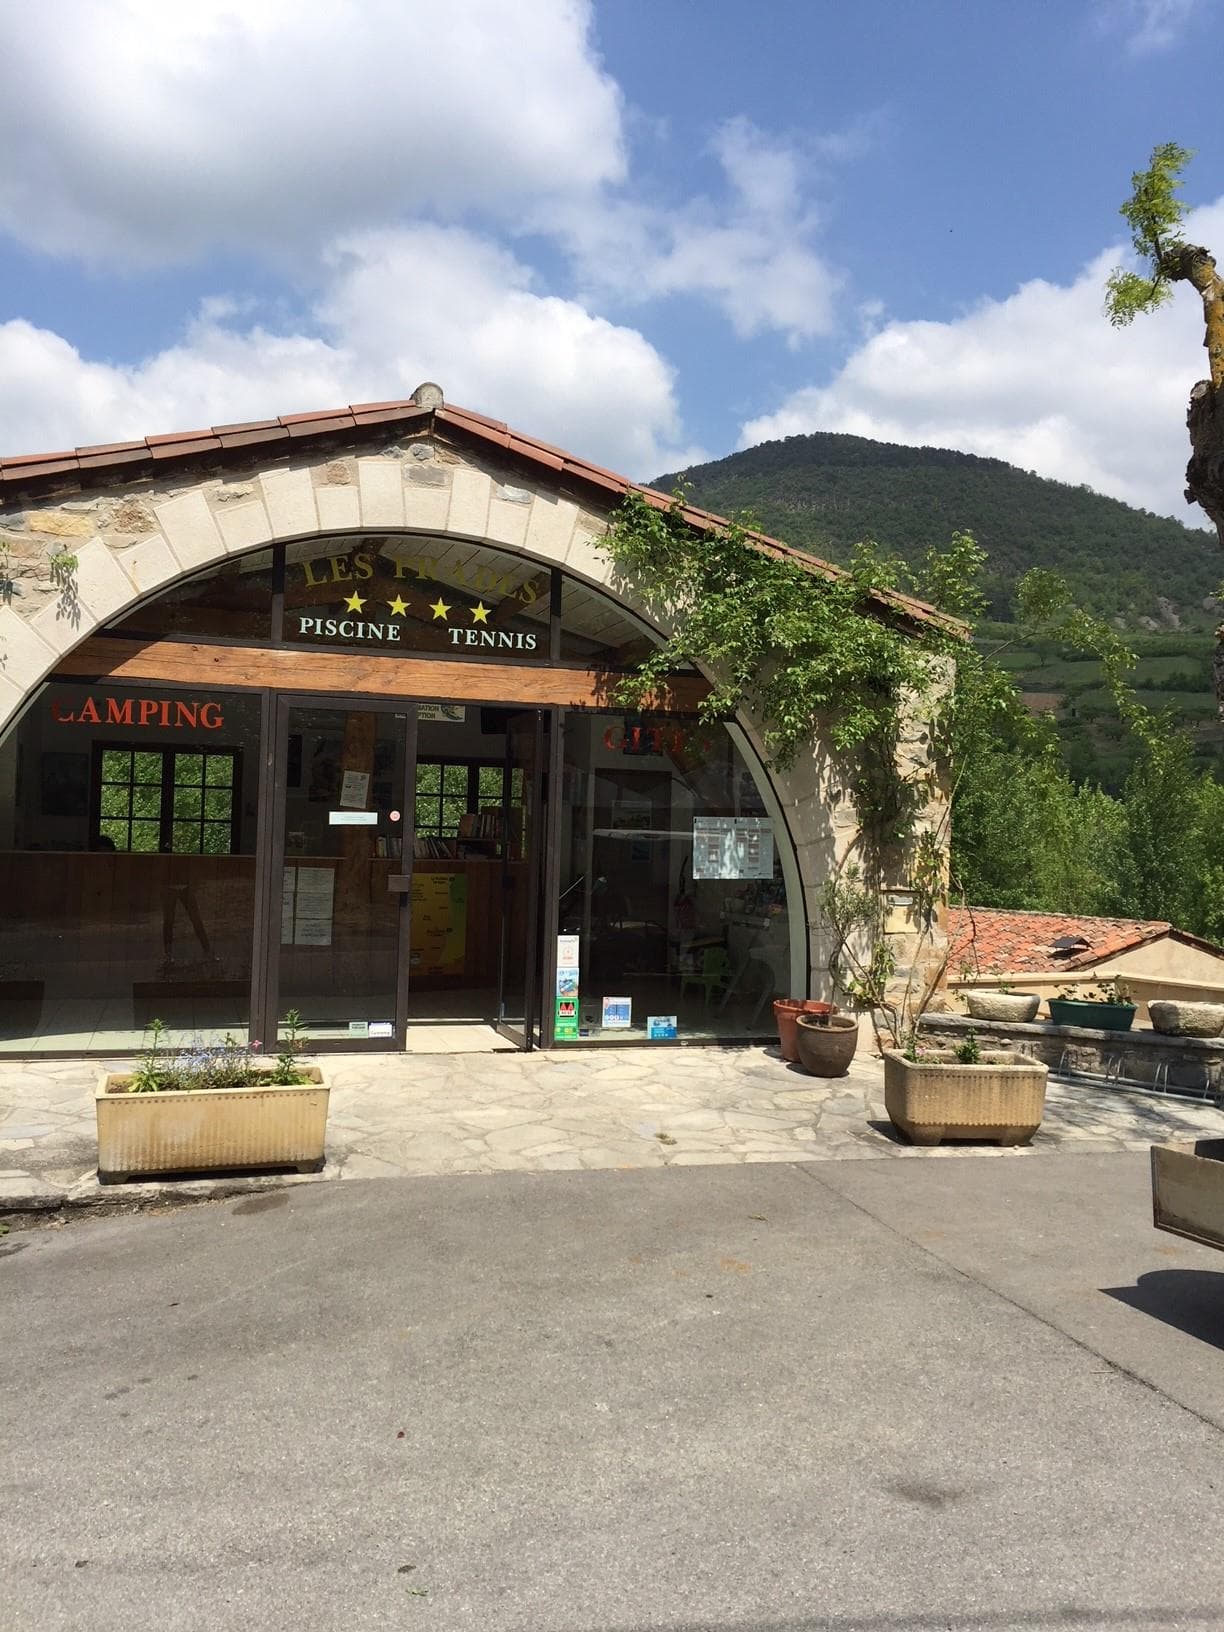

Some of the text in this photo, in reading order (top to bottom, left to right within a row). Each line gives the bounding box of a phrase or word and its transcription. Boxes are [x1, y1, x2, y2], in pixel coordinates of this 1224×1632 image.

[303, 553, 374, 586] LES
[299, 616, 401, 642] PISCINE
[448, 627, 537, 650] TENNIS
[51, 696, 225, 729] CAMPING
